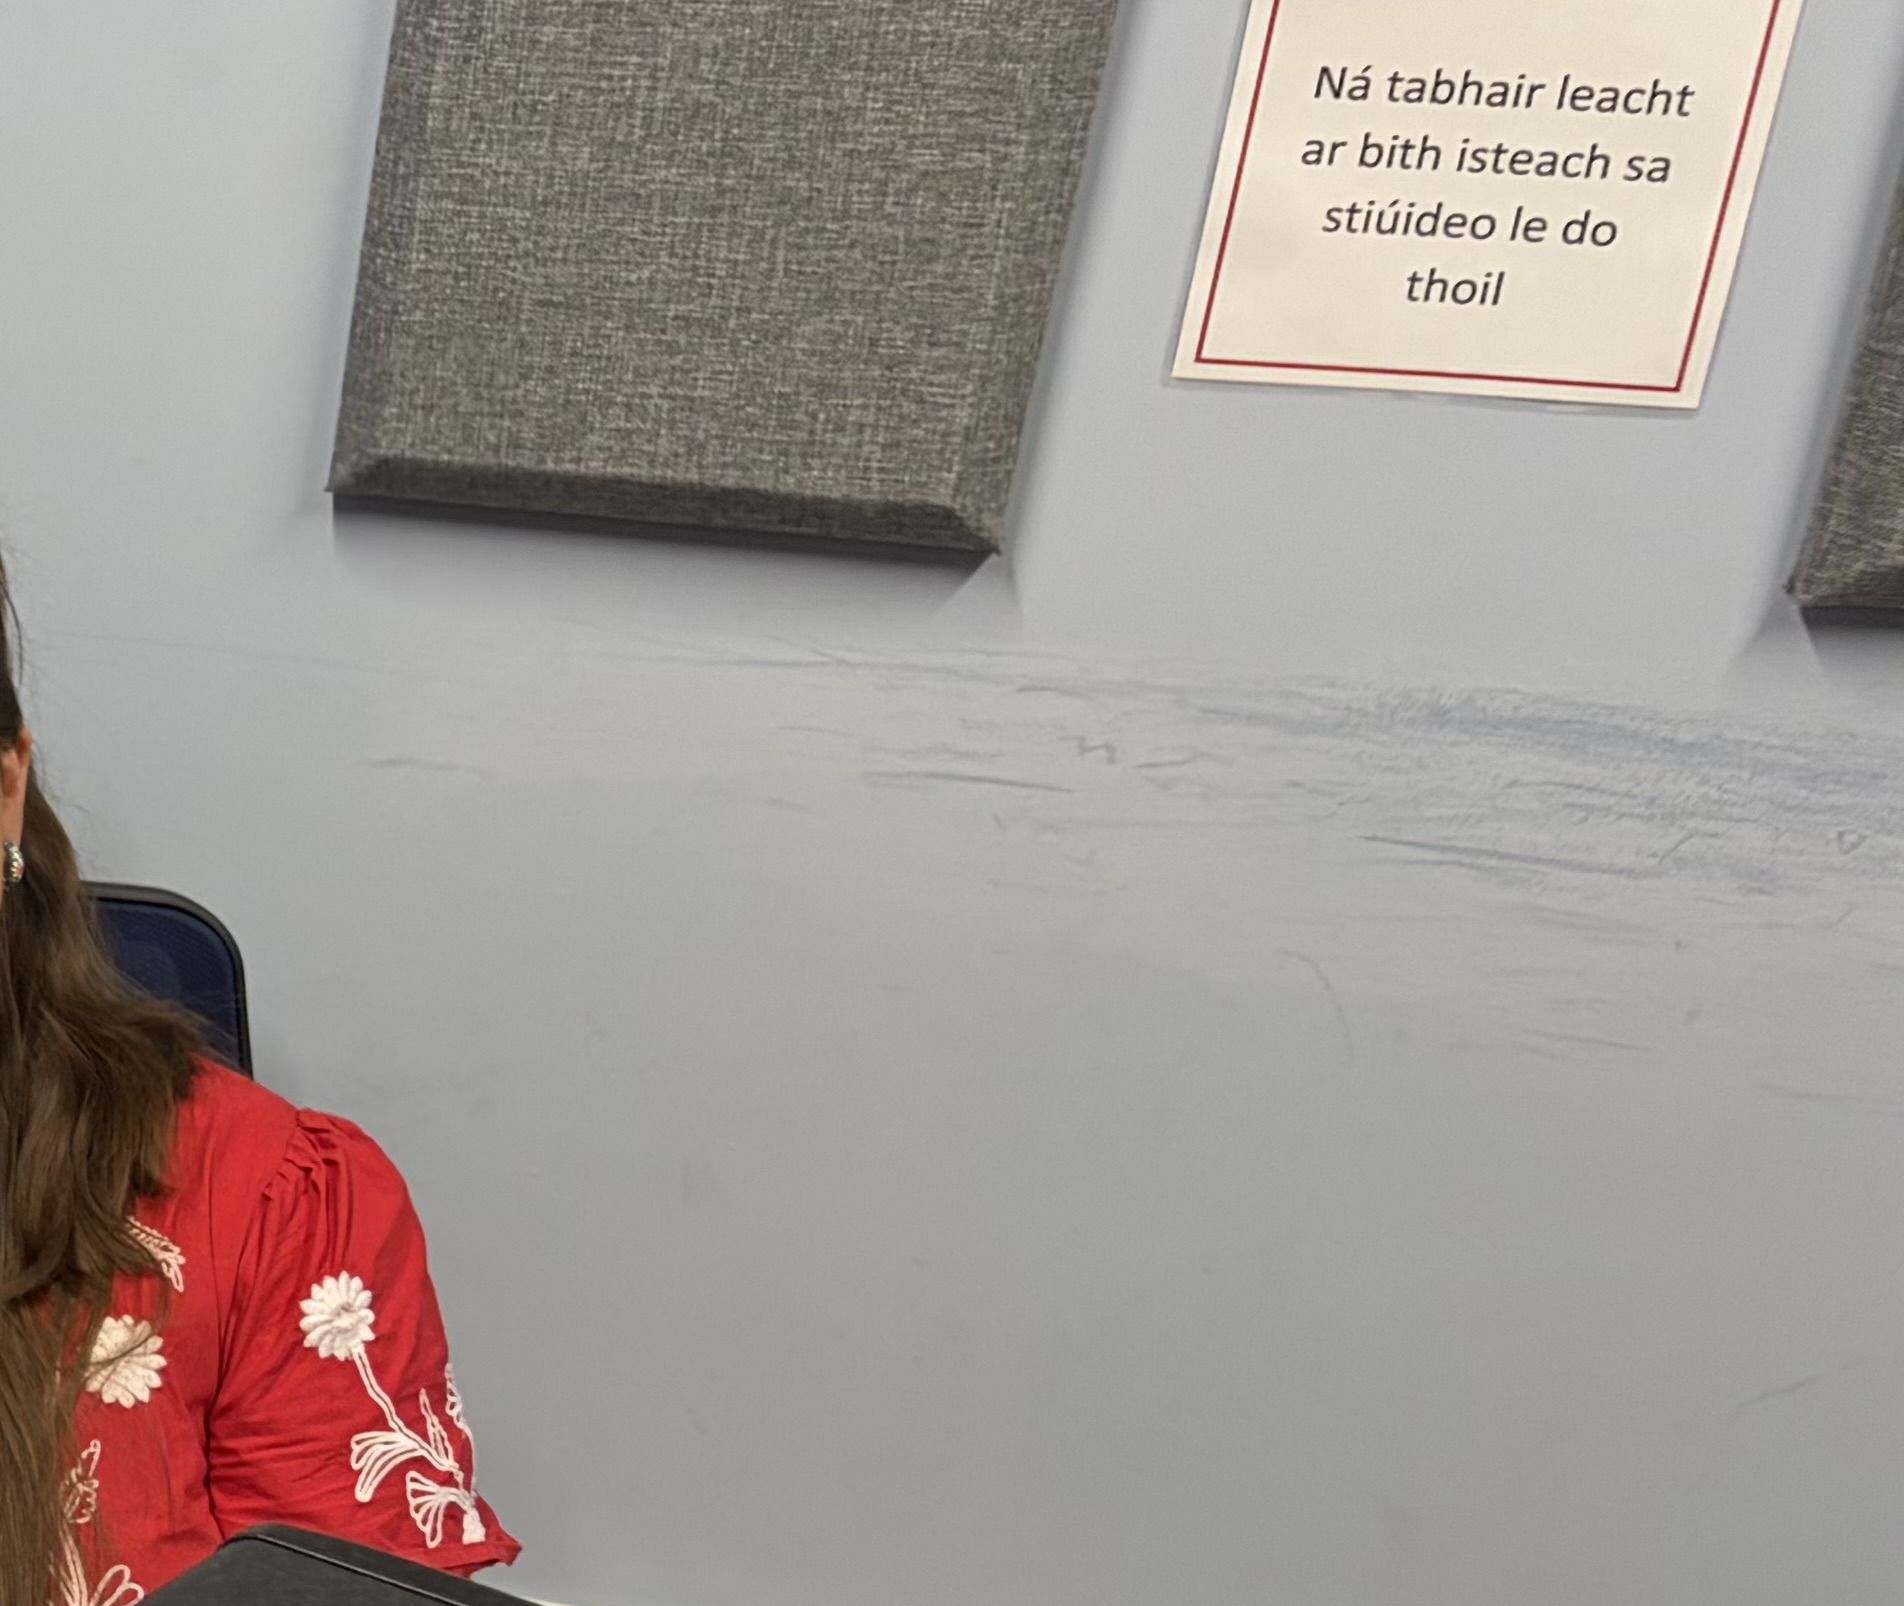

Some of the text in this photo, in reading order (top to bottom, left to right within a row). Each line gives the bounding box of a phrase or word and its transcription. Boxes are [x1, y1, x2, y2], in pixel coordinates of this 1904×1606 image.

[1313, 65, 1695, 118] Ná tabhair leacht
[1301, 131, 1672, 183] ar bith isteach sa
[1321, 200, 1618, 248] stiúideo le do
[1406, 270, 1505, 308] thoil
